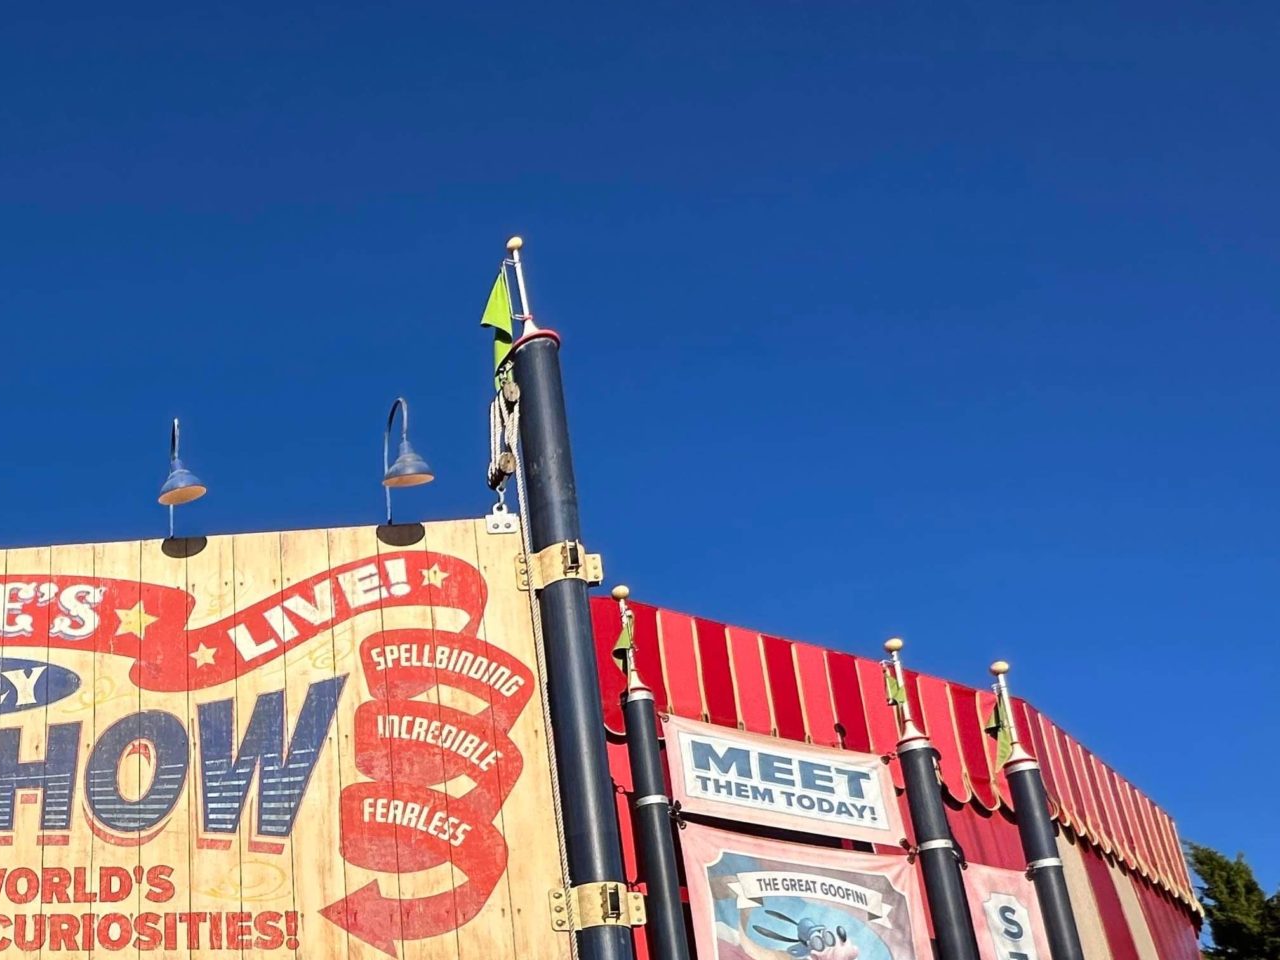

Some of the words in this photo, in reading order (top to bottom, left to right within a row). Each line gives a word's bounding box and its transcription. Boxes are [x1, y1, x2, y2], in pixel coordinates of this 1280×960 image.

[227, 558, 411, 662] LIVE!
[371, 643, 524, 697] SPELLBINDING
[378, 715, 503, 771] INCREDIBLE
[690, 740, 872, 800] MEET
[363, 798, 470, 848] FEARLESS
[695, 775, 775, 804] THEM
[779, 790, 879, 821] TODAY!
[756, 877, 781, 892] THE
[781, 878, 817, 895] GREAT
[820, 881, 868, 906] GOOFINI
